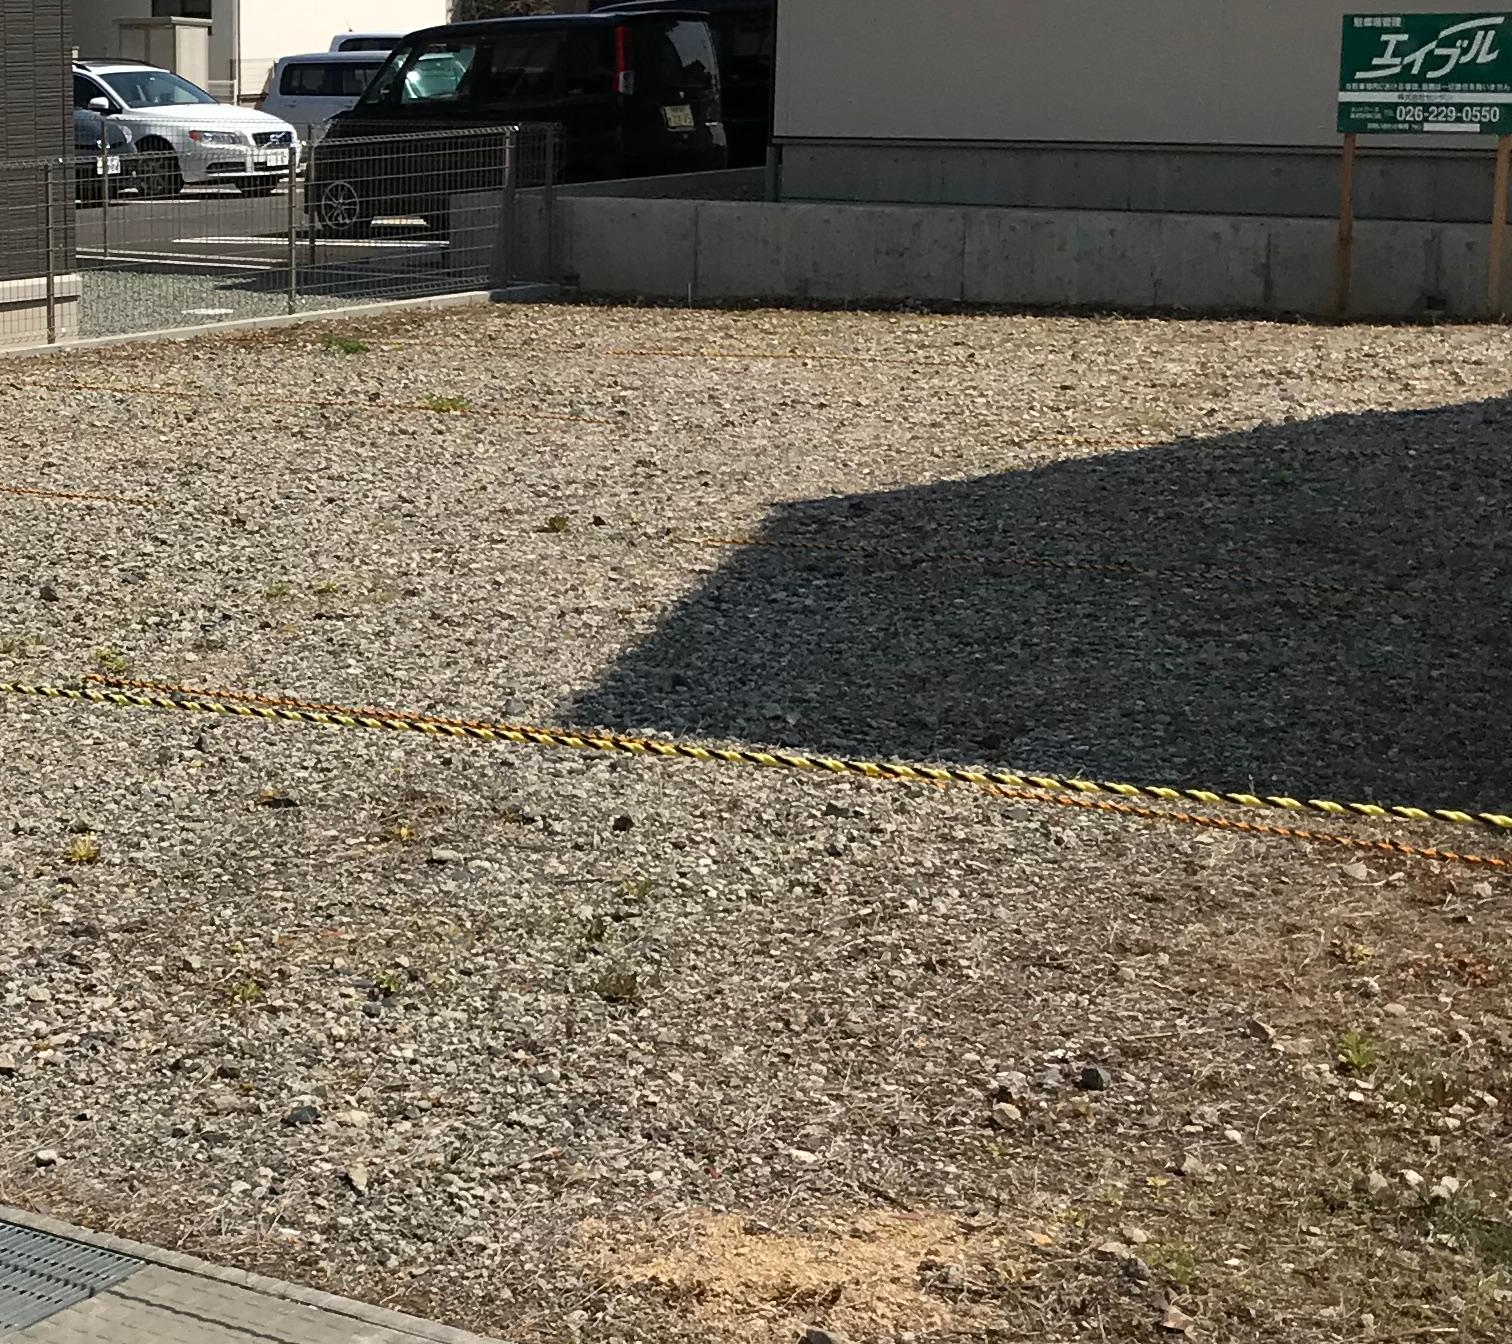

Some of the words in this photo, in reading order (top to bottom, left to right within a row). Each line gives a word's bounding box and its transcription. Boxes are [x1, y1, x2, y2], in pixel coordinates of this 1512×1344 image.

[1370, 28, 1502, 79] エイブル
[1396, 106, 1500, 123] 026-229-0550
